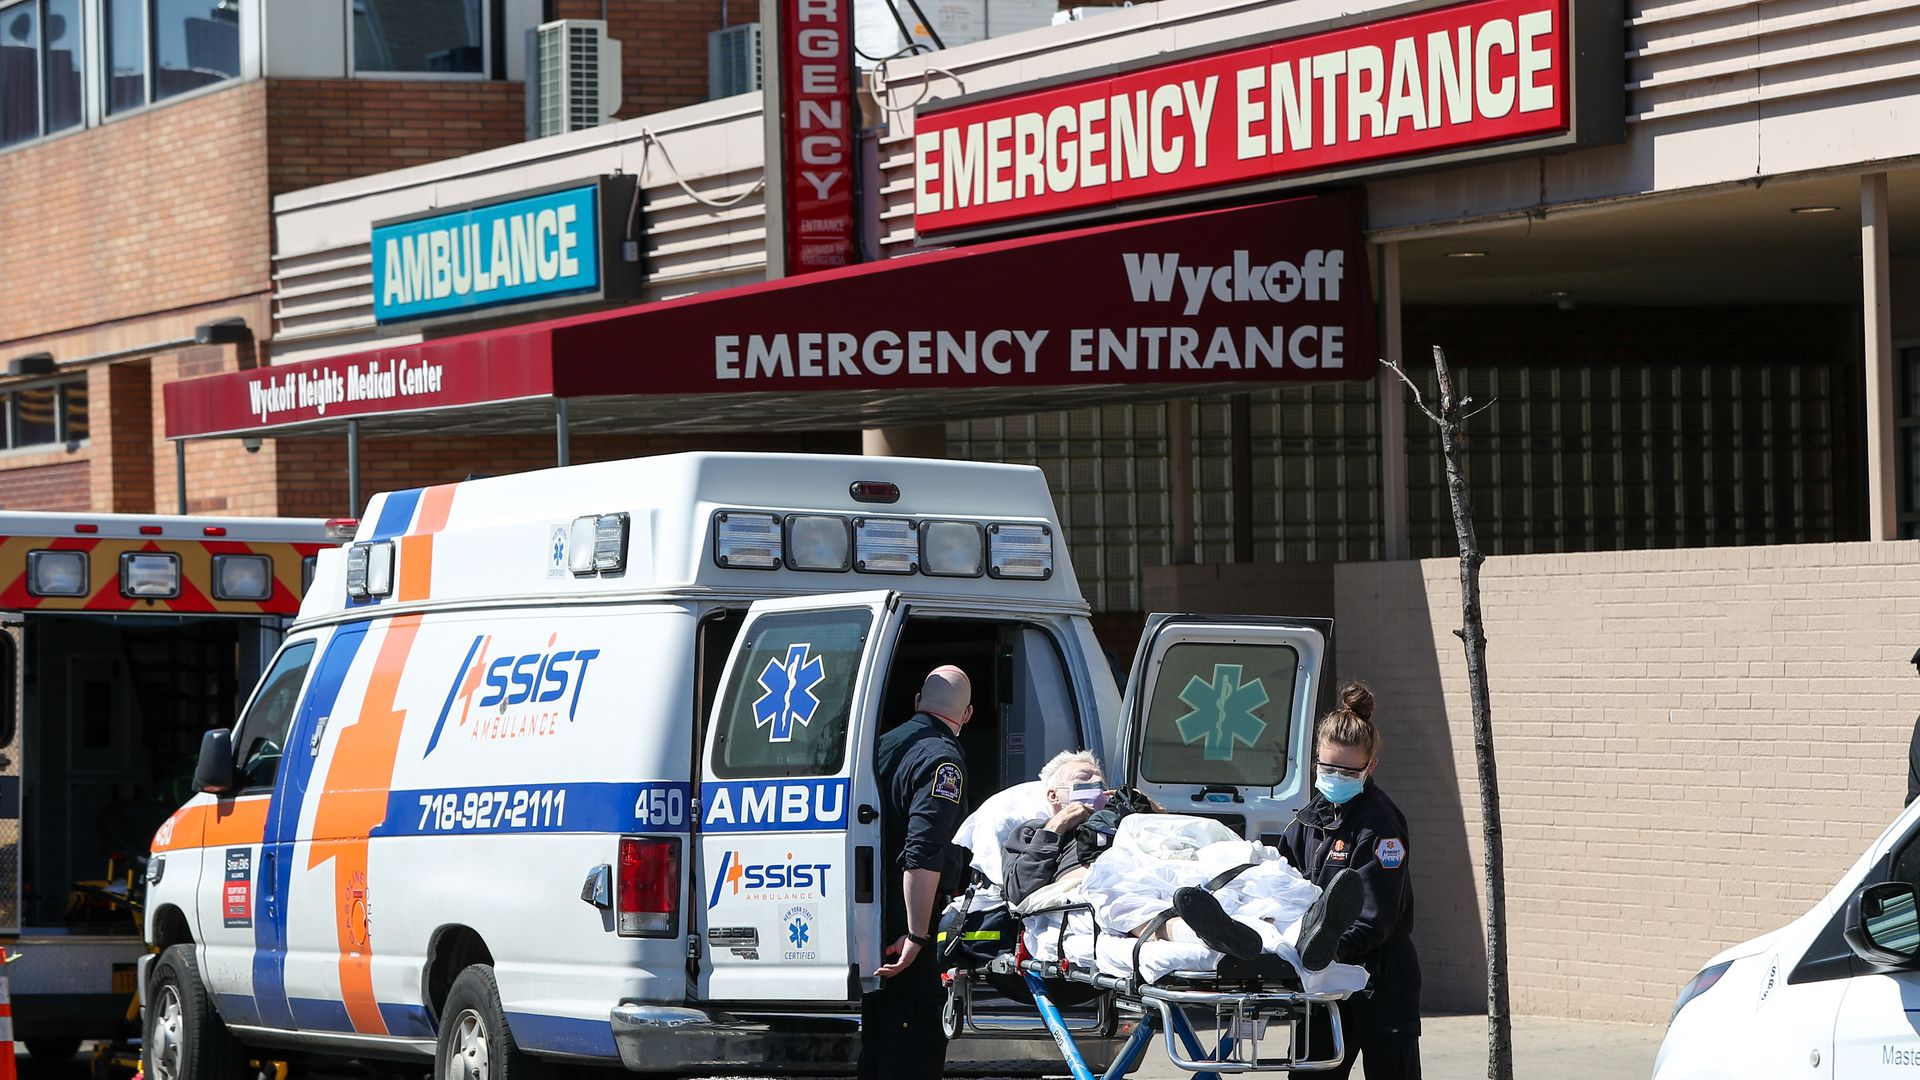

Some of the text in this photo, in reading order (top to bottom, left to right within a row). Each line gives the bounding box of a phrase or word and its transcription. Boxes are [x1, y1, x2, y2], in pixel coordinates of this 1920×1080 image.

[915, 10, 1554, 215] EMERGENCY ENTRANCE
[801, 219, 845, 232] ENTRANCE
[383, 204, 579, 306] AMBULANCE
[1122, 250, 1344, 315] Wyckoff
[715, 325, 1344, 379] EMERGENCY ENTRANCE
[249, 359, 442, 423] Wyckoff Heights Medical Center
[471, 712, 558, 741] AMBULANCE
[418, 788, 683, 830] 718-927-2111 450
[705, 784, 844, 824] AMBU
[783, 906, 813, 921] NEW YORK STATE
[785, 952, 815, 960] CERTIFIED
[1761, 966, 1776, 1000] SBS
[1883, 1045, 1920, 1066] Maste
